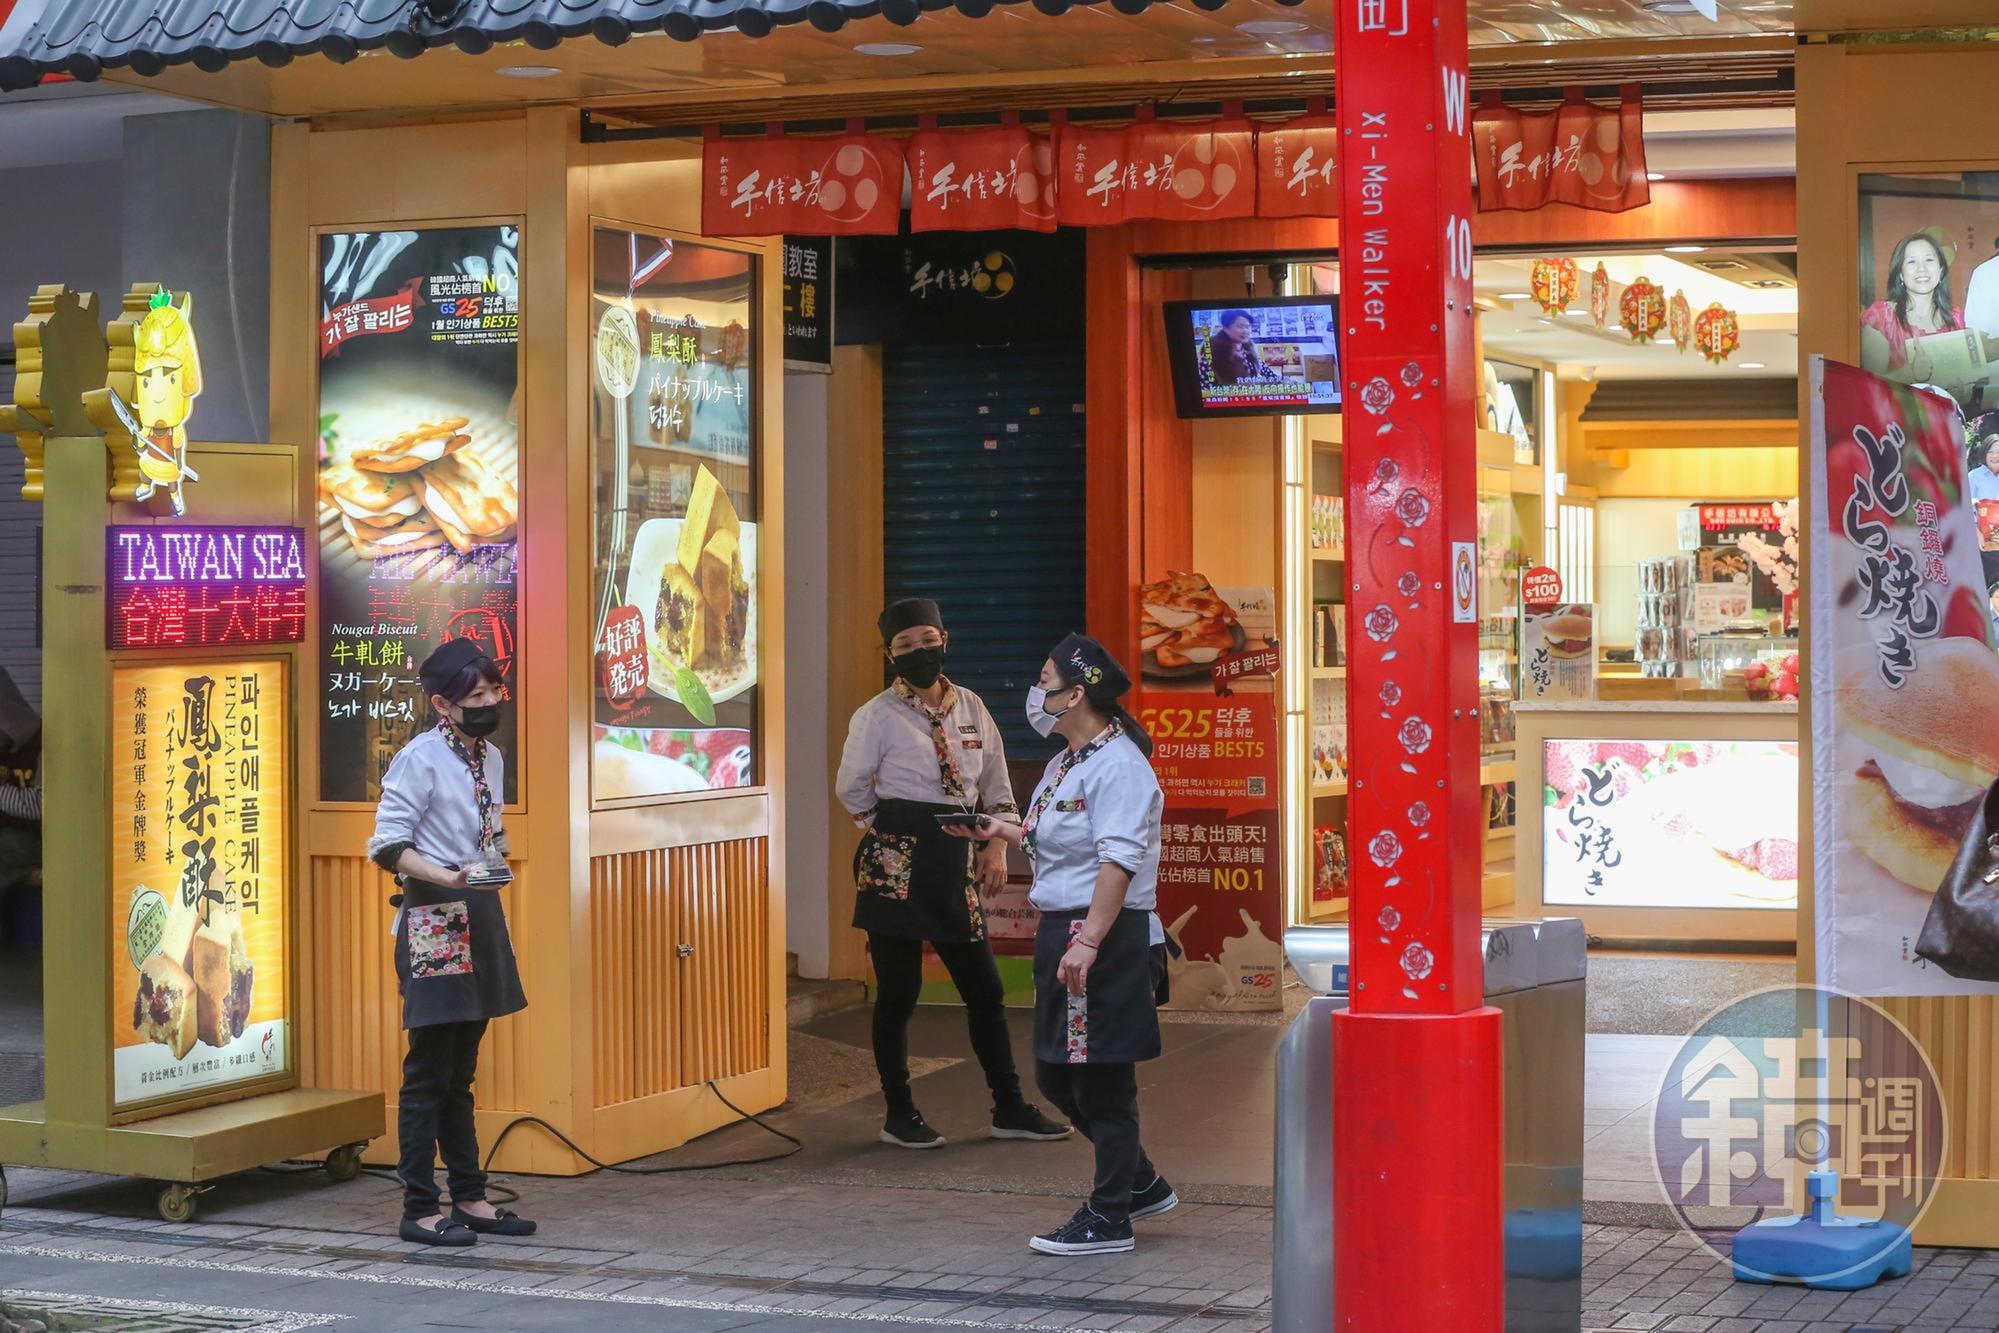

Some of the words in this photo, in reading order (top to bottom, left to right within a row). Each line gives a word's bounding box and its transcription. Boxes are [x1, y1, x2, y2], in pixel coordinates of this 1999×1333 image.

[1442, 65, 1466, 136] W
[731, 169, 821, 218] 手信坊
[1087, 154, 1175, 207] 手信坊
[1446, 214, 1471, 281] 10
[363, 304, 412, 331] 팔리는
[482, 315, 518, 328] BEST5
[650, 332, 698, 366] 鳳梨酥
[648, 373, 743, 405] パイナップルケーキ
[119, 534, 245, 581] TAIWAN
[252, 534, 306, 581] SEA
[1843, 420, 1941, 690] どら焼き
[1525, 584, 1559, 598] $100
[330, 640, 404, 666] 牛軋餅
[332, 624, 375, 638] Nougat
[377, 622, 418, 635] Biscuit
[605, 614, 641, 661] 好評
[609, 654, 645, 700] 発売
[1215, 662, 1227, 677] 가
[1230, 660, 1240, 675] 잘
[1242, 651, 1277, 673] 팔리는
[1216, 707, 1252, 728] 덕후
[224, 675, 236, 824] PINEAPPLE
[1159, 743, 1211, 759] 인기상품
[1214, 741, 1264, 758] BEST5
[165, 709, 176, 865] パイナップルケーキ
[177, 675, 224, 928] 鳳梨酥
[240, 673, 260, 915] 파인애플케익
[1568, 761, 1622, 897] どら焼き
[224, 839, 237, 914] CAKE
[1214, 867, 1265, 892] NO.1
[1241, 972, 1276, 989] GS25
